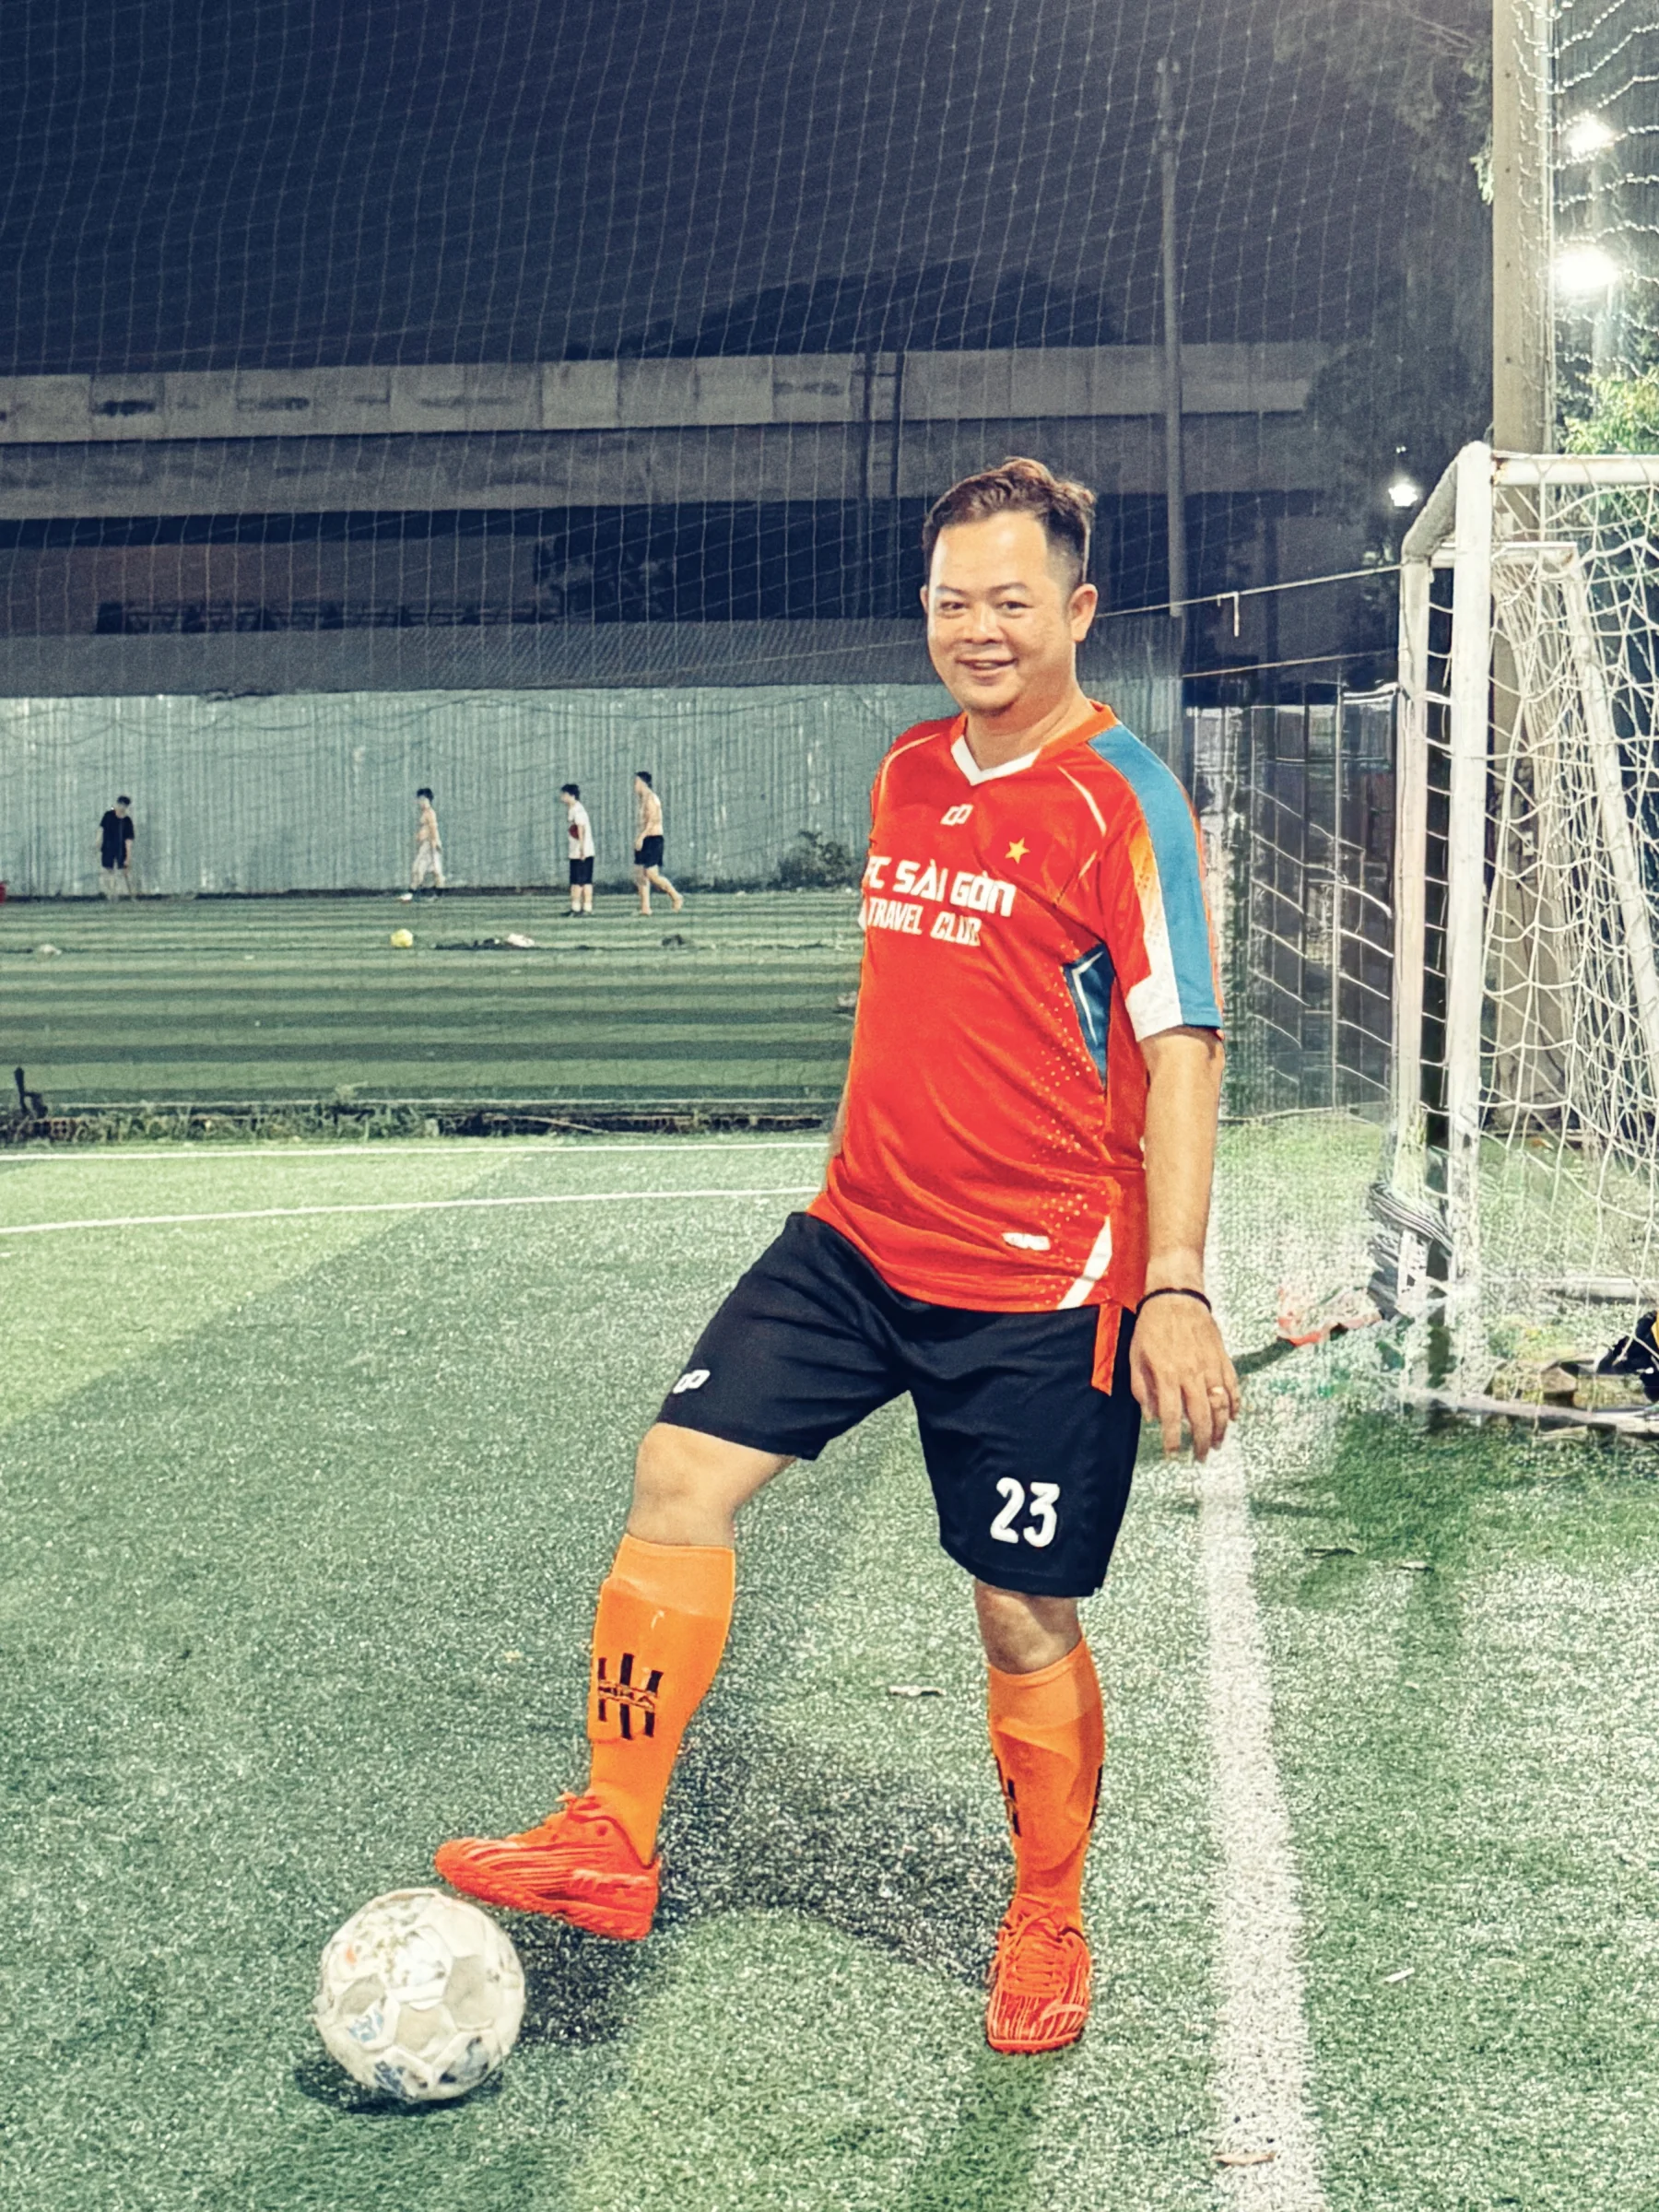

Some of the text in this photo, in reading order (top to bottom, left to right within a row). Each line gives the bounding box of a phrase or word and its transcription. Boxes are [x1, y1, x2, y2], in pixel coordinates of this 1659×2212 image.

[892, 858, 948, 902] SÀI
[867, 897, 982, 947] TRAVEL CLUB
[990, 1477, 1060, 1547] 23
